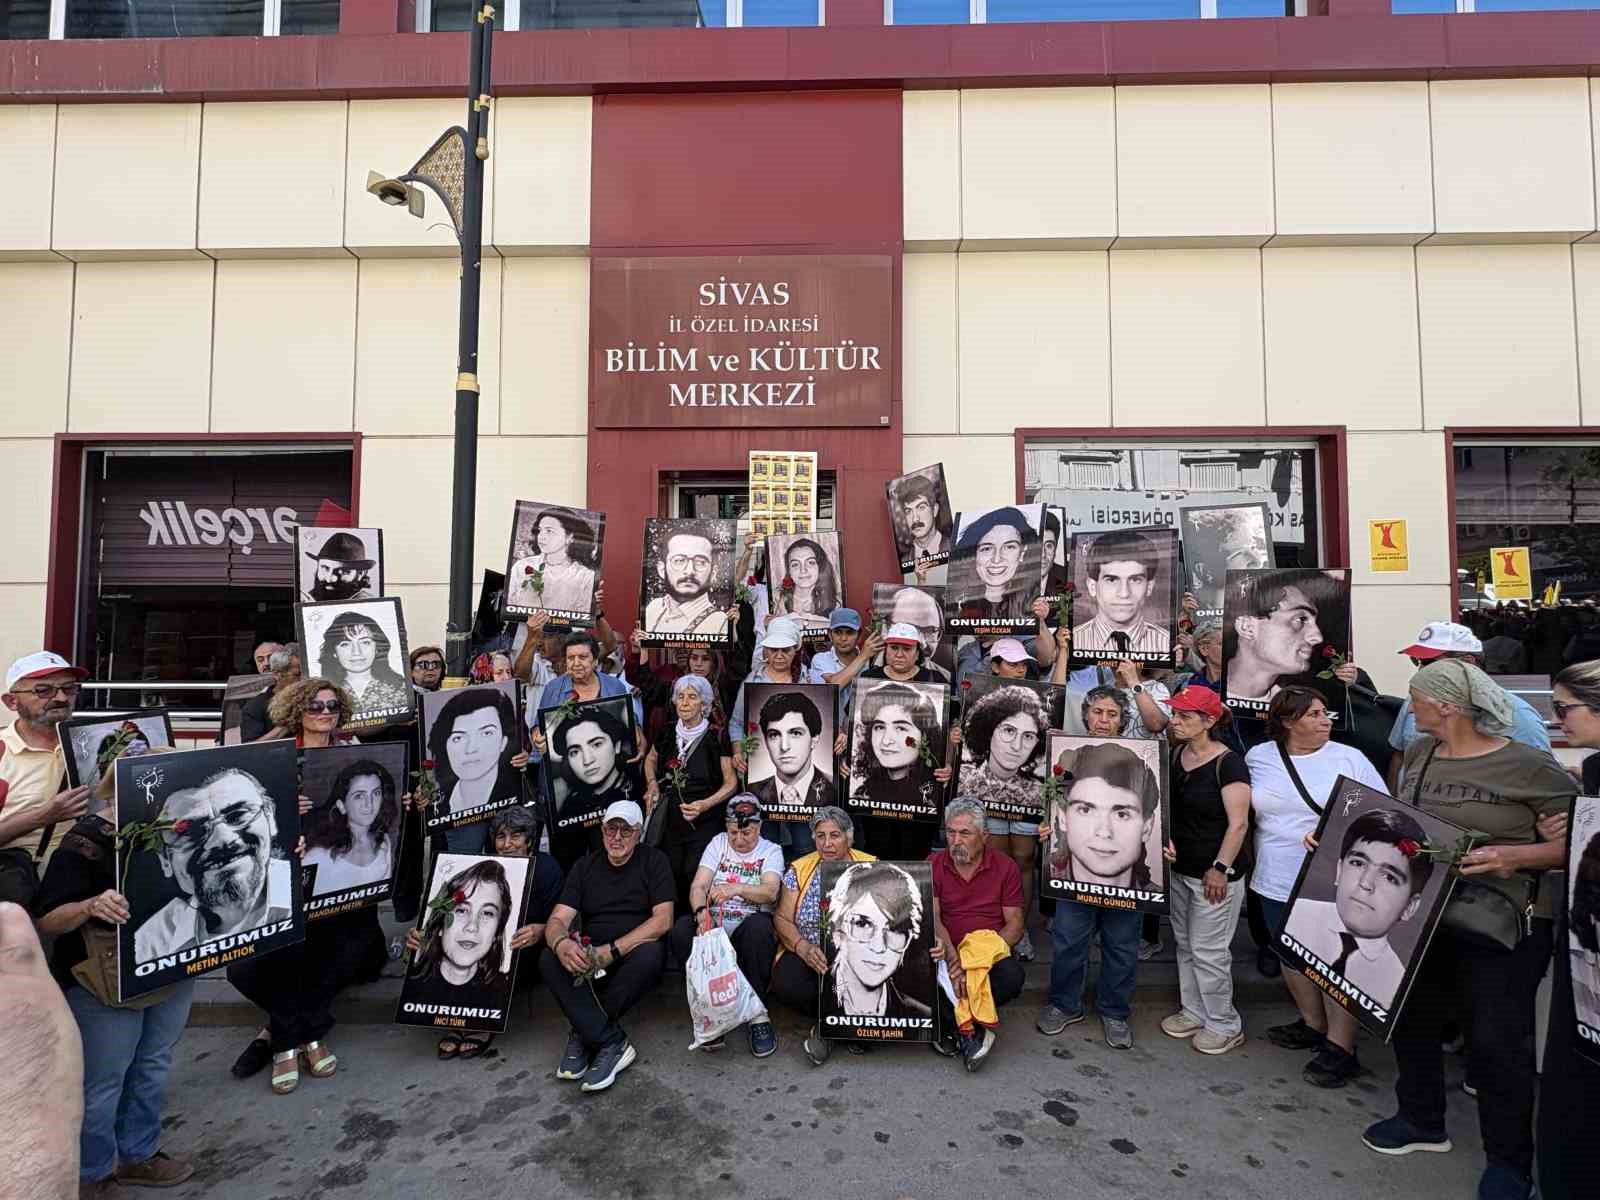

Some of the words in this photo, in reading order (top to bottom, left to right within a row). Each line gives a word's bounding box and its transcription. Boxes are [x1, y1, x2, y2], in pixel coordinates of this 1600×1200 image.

[699, 275, 790, 306] SİVAS
[669, 315, 686, 333] İL
[691, 315, 738, 333] ÖZEL
[743, 314, 819, 333] İDARESİ
[605, 341, 699, 372] BİLİM
[707, 353, 740, 372] ve
[749, 339, 881, 371] KÜLTÜR
[668, 375, 817, 407] MERKEZİ
[505, 605, 592, 620] ONUUMUZ
[950, 618, 1037, 627] ONURUMUZ
[647, 633, 729, 642] ONURUMUZ
[1072, 650, 1171, 661] ONURUMUZ
[427, 796, 518, 827] ONURUMUZ
[848, 799, 938, 815] ONURUMUZ
[1049, 879, 1165, 903] ONURUMUZ
[134, 918, 294, 977] ONURUMUZ
[186, 956, 219, 975] METİN
[221, 944, 255, 963] ALTIOK
[1280, 934, 1389, 1023] ONURUMUZ
[403, 1002, 502, 1019] ONURUMUZ
[825, 1015, 933, 1028] ONURUMUZ
